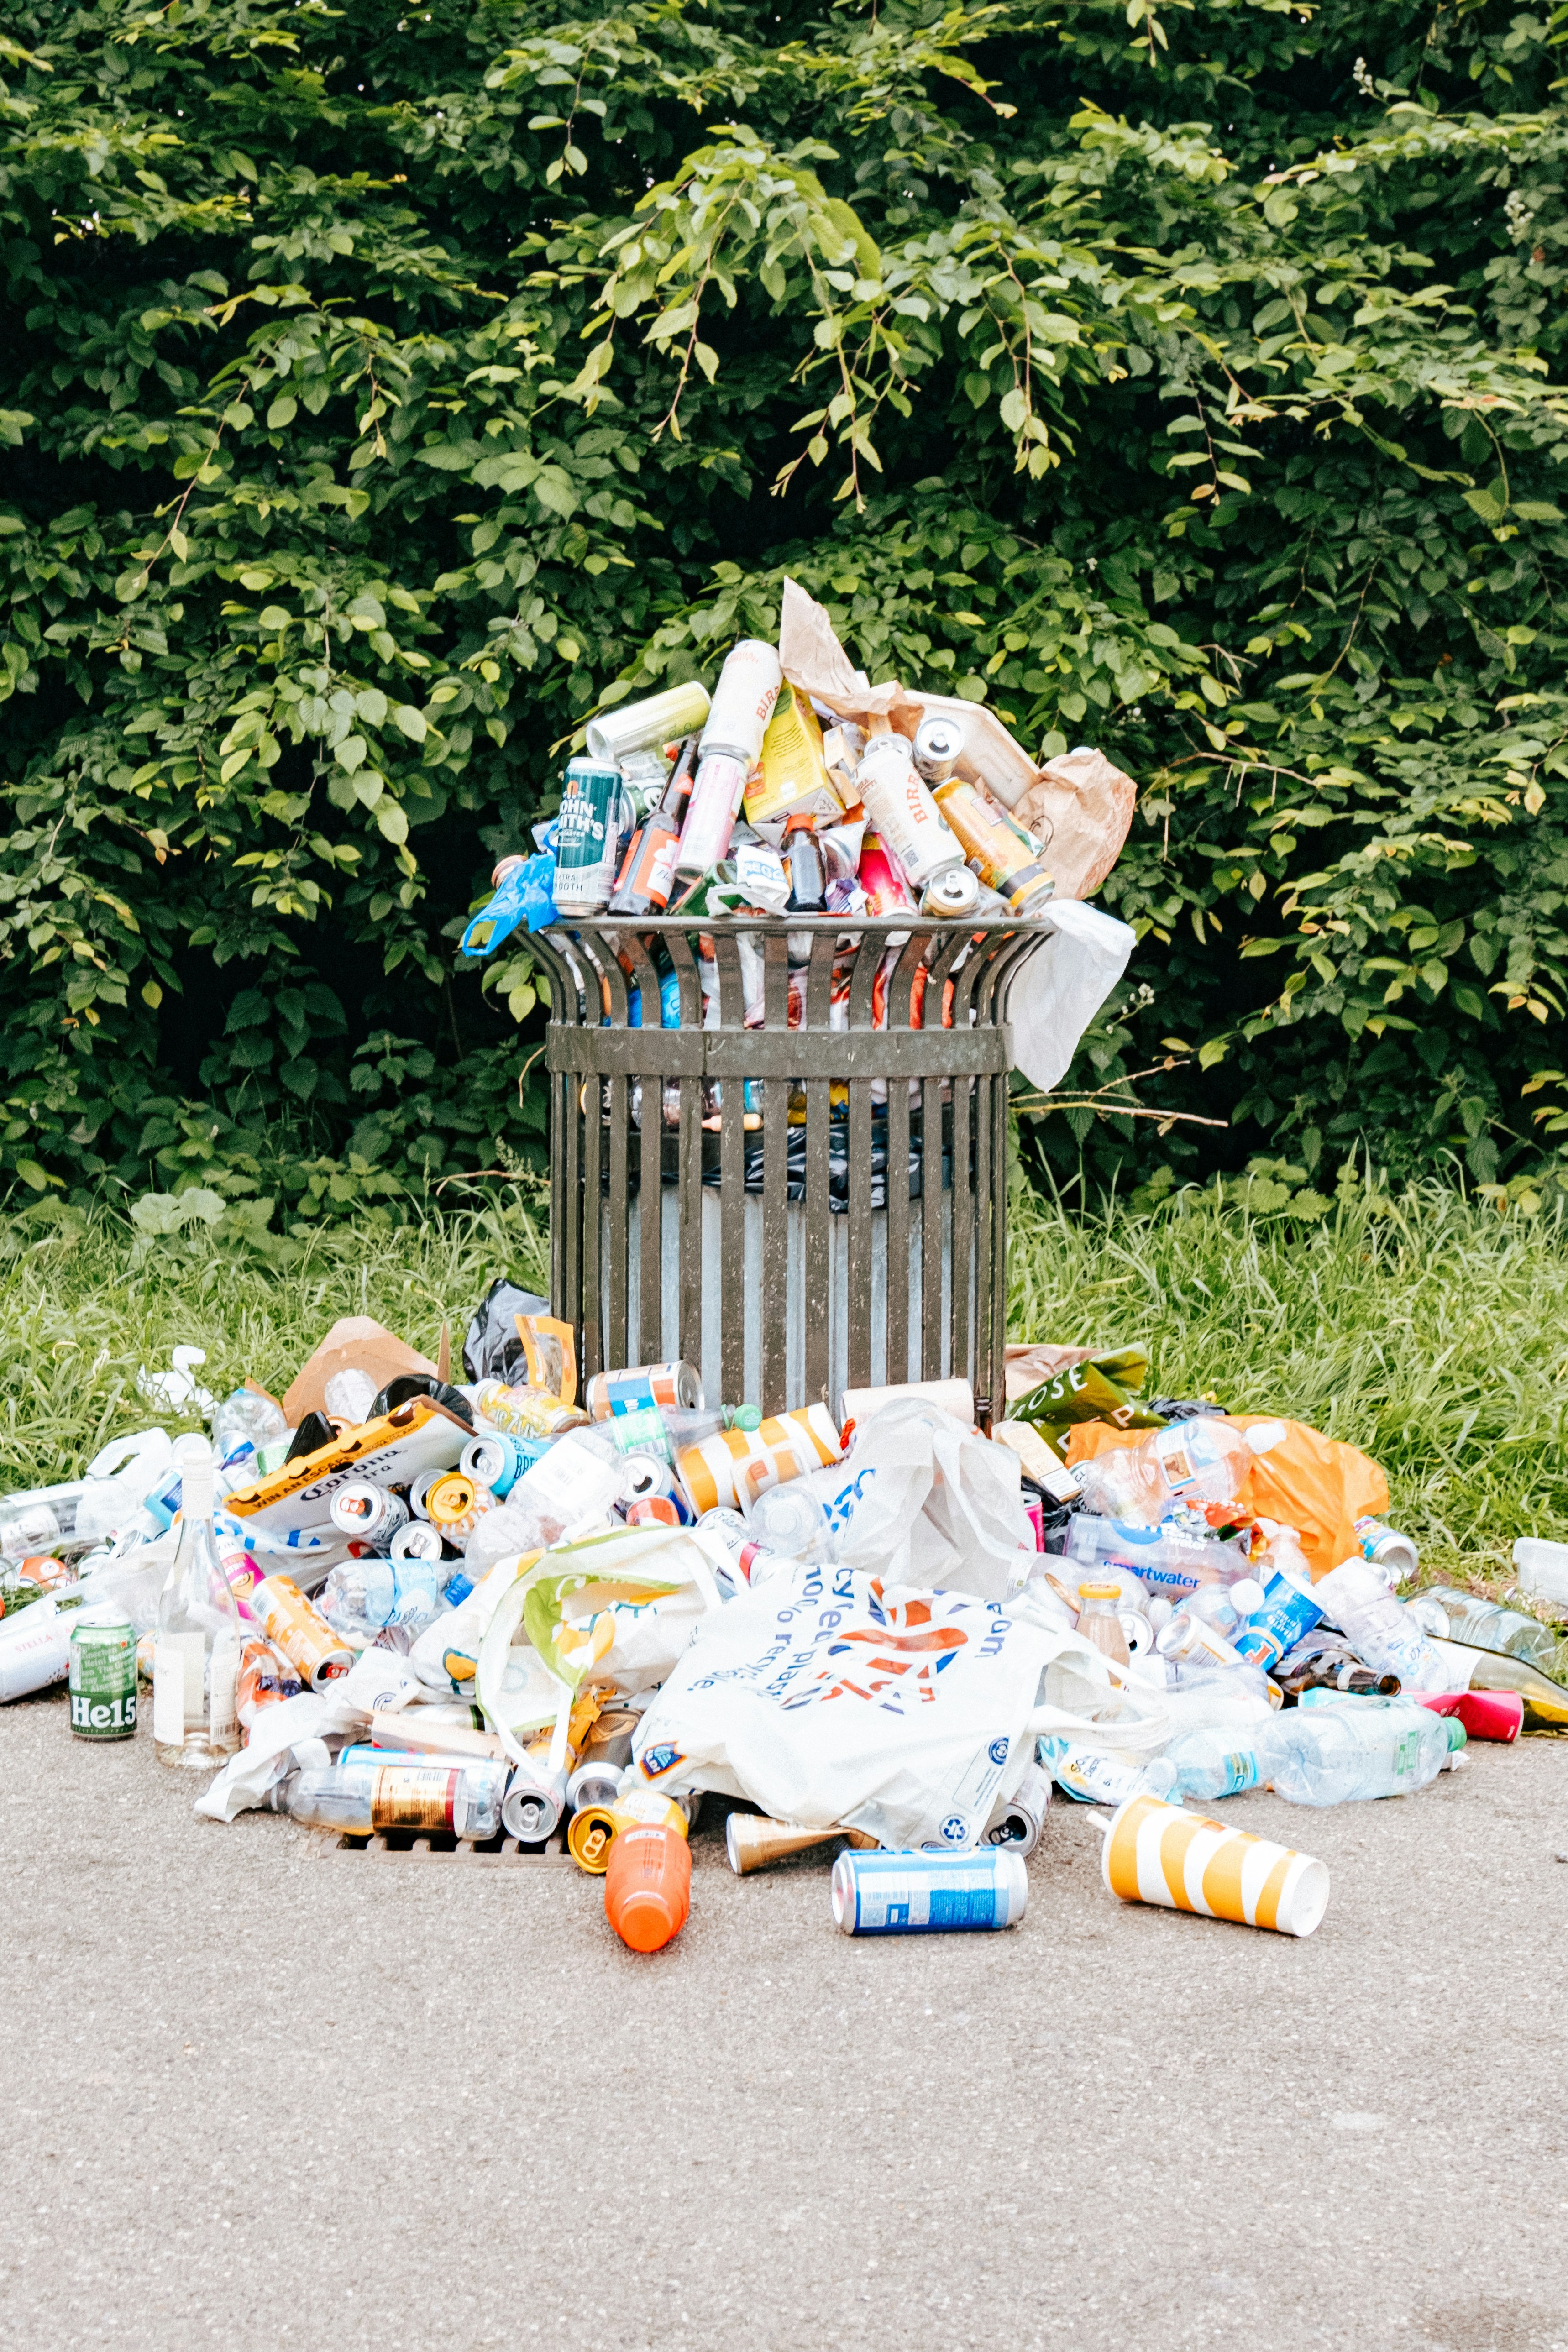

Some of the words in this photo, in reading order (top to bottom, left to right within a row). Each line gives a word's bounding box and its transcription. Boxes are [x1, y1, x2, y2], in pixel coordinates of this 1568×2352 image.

[560, 799, 597, 818] OHN'
[300, 1449, 403, 1501] Corona
[362, 1464, 393, 1480] tra
[253, 1493, 281, 1508] WIN
[283, 1482, 302, 1494] AN
[1103, 1561, 1201, 1588] artwater
[72, 1695, 136, 1729] He15
